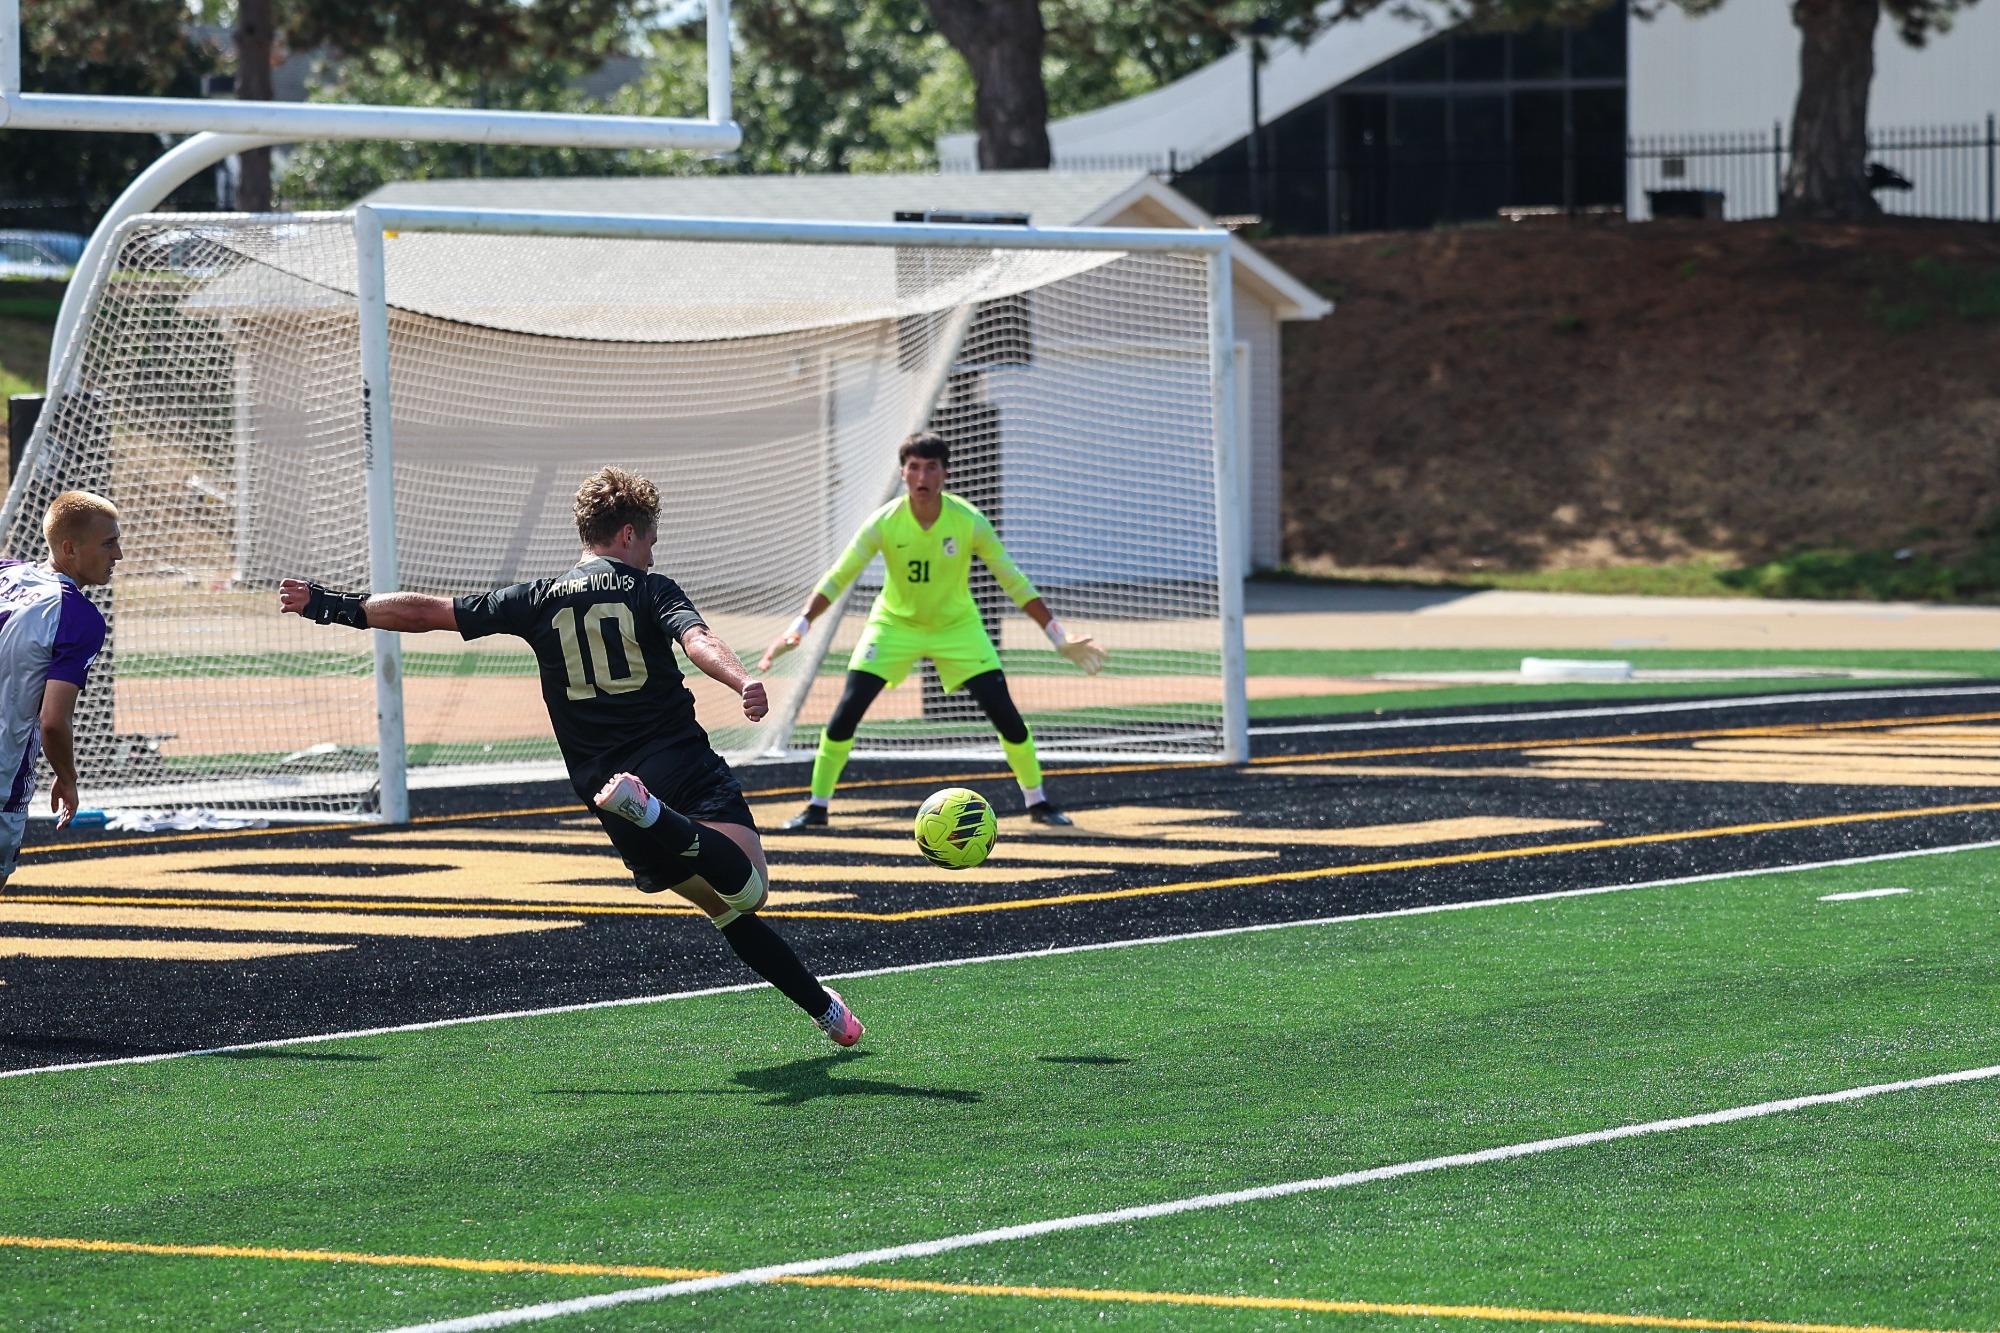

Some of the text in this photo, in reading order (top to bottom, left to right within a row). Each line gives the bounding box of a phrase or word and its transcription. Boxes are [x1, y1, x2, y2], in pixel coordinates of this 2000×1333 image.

[590, 572, 635, 592] WOLVES
[908, 560, 930, 583] 31
[552, 602, 649, 701] 10
